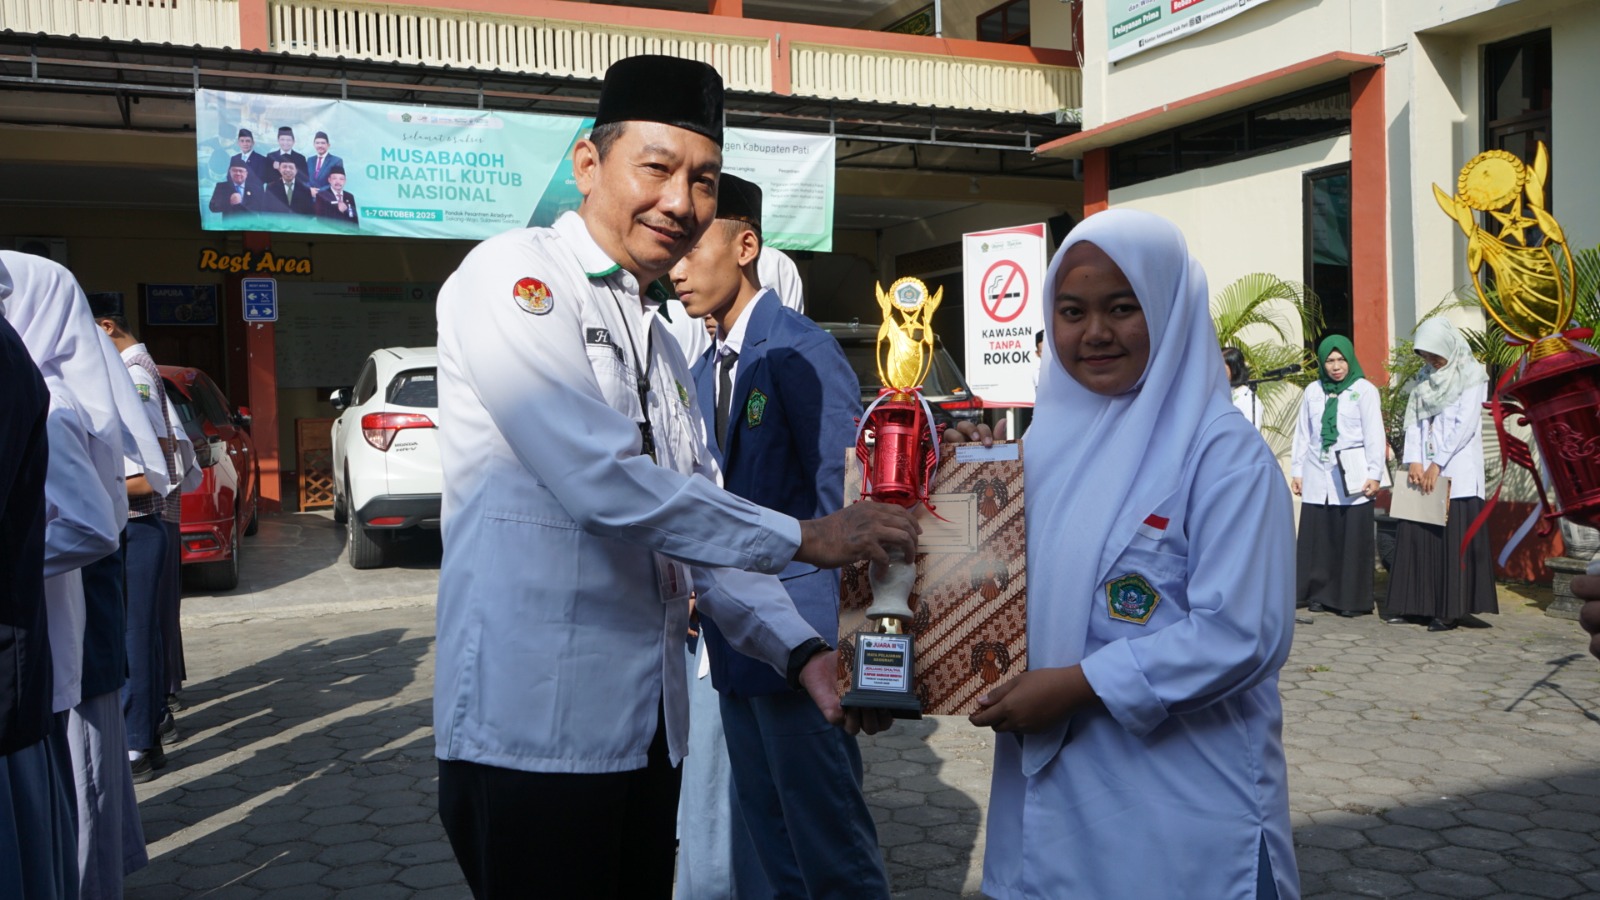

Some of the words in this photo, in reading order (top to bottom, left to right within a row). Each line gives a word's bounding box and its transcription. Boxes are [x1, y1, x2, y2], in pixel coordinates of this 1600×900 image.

[1114, 18, 1142, 36] Pelayanan
[1142, 10, 1160, 23] Prima
[743, 143, 791, 154] Kabupaten
[792, 145, 810, 155] Pati
[381, 147, 504, 168] MUSABAQOH
[365, 164, 456, 183] QIRAATIL
[461, 169, 522, 187] KUTUB
[397, 184, 496, 203] NASIONAL
[365, 209, 377, 217] 1-7
[378, 209, 415, 218] OKTOBER
[415, 211, 436, 219] 2025
[200, 249, 252, 273] Rest
[255, 252, 311, 274] Area
[152, 289, 183, 297] GAPURA
[982, 326, 1032, 339] KAWASAN
[989, 340, 1022, 351] TANPA
[984, 351, 1031, 365] ROKOK
